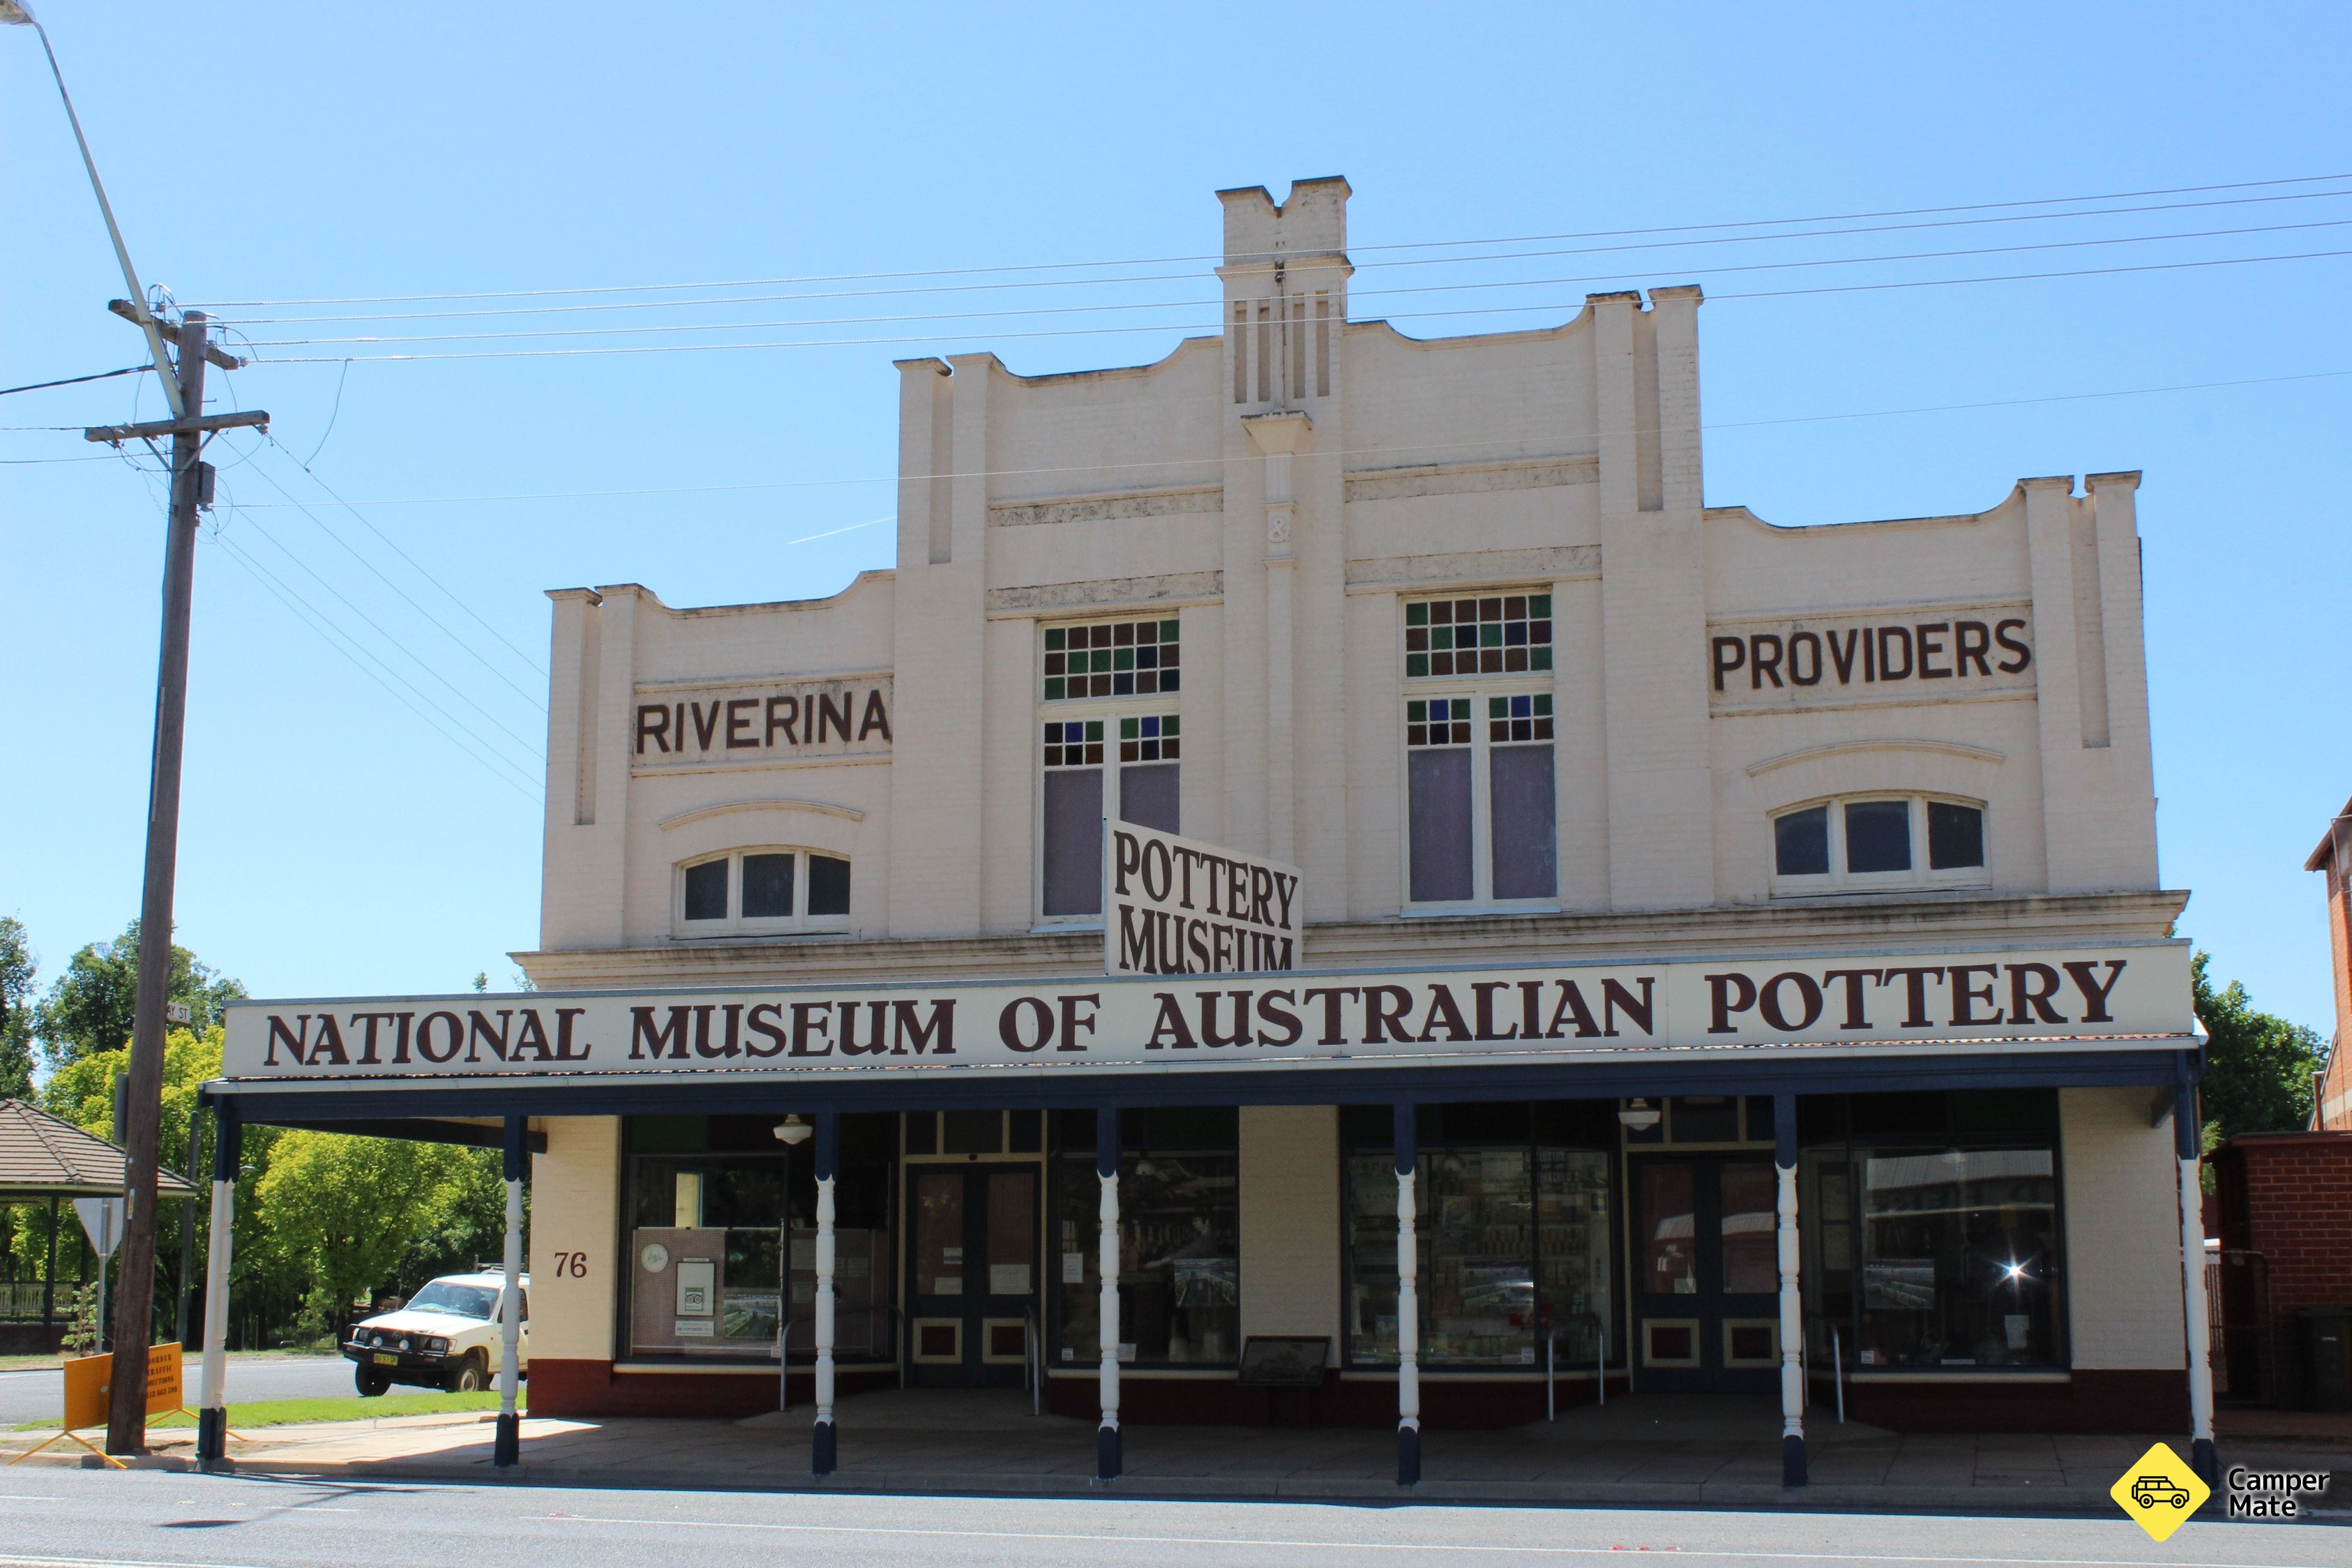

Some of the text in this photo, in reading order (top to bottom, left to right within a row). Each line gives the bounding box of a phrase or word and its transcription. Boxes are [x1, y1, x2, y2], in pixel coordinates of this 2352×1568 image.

[1268, 516, 1290, 541] &
[1712, 619, 2031, 691] PROVIDERS
[636, 690, 891, 754] RIVERINA
[1113, 829, 1298, 930] POTTERY
[1118, 904, 1293, 974] MUSEUM
[179, 1007, 188, 1019] ST
[264, 960, 2127, 1066] NATIONAL MUSEUM OF AUSTRALIAN POTTERY
[554, 1251, 587, 1278] 76
